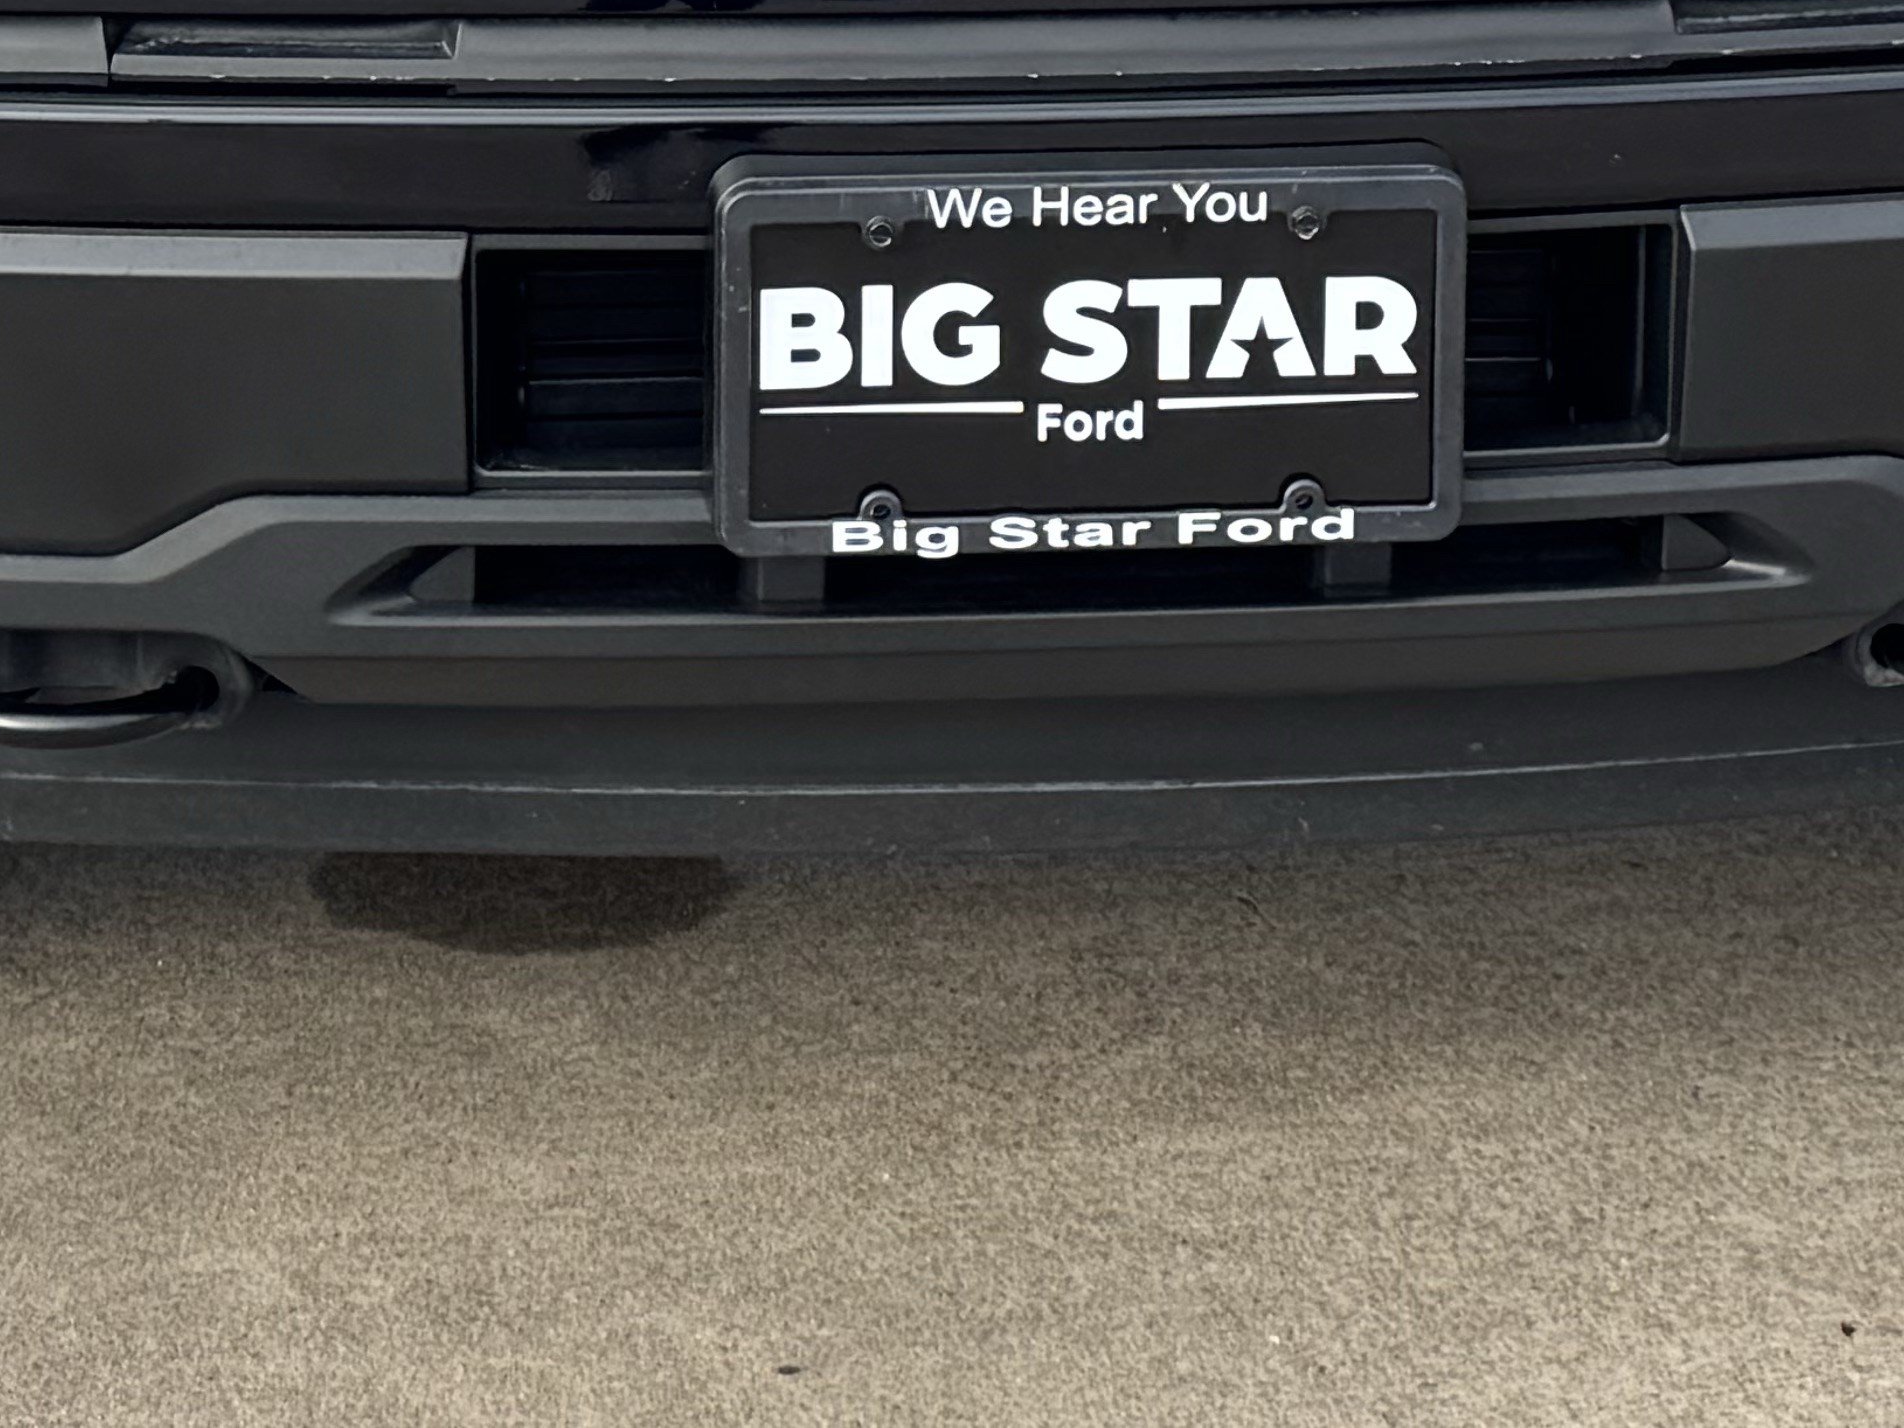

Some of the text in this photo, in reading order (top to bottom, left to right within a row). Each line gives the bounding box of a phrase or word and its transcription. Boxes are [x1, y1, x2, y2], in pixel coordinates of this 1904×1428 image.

[927, 182, 1268, 228] We Hear You
[759, 276, 1418, 391] BIG STAR
[1037, 400, 1144, 442] Ford
[831, 507, 1355, 560] Big Star Ford
